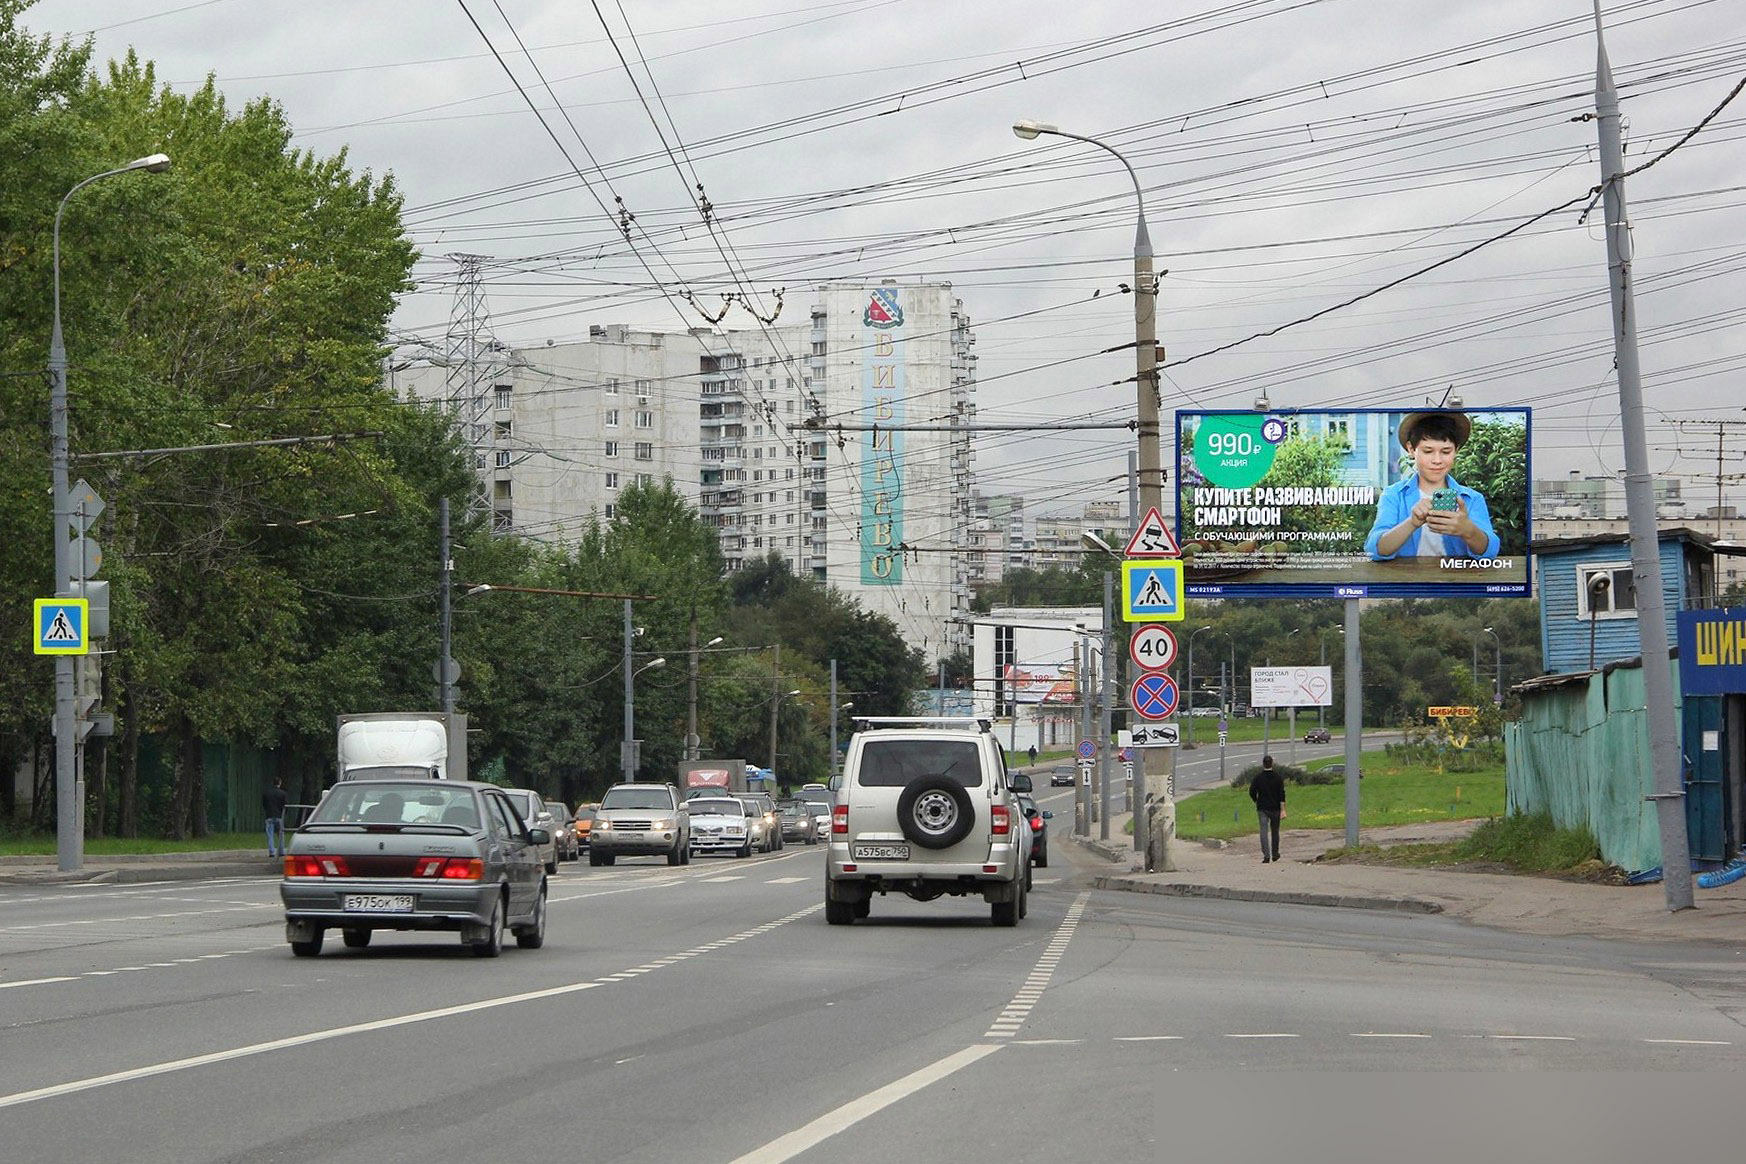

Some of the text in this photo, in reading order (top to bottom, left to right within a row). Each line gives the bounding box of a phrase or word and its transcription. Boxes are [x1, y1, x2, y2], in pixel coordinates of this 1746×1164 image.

[871, 332, 896, 579] БИБИРЕВО
[1220, 459, 1248, 467] АКЦИЯ
[1194, 486, 1375, 506] КУПИТЕ РАЗВИВАЮЩИЙ
[1194, 507, 1281, 526] СМАРТФОН
[1194, 531, 1352, 542] С ОБУЧАЮЩИМИ ПРОГРАММАМИ
[1140, 638, 1168, 657] 40
[1430, 708, 1477, 716] БИБИРЕВ
